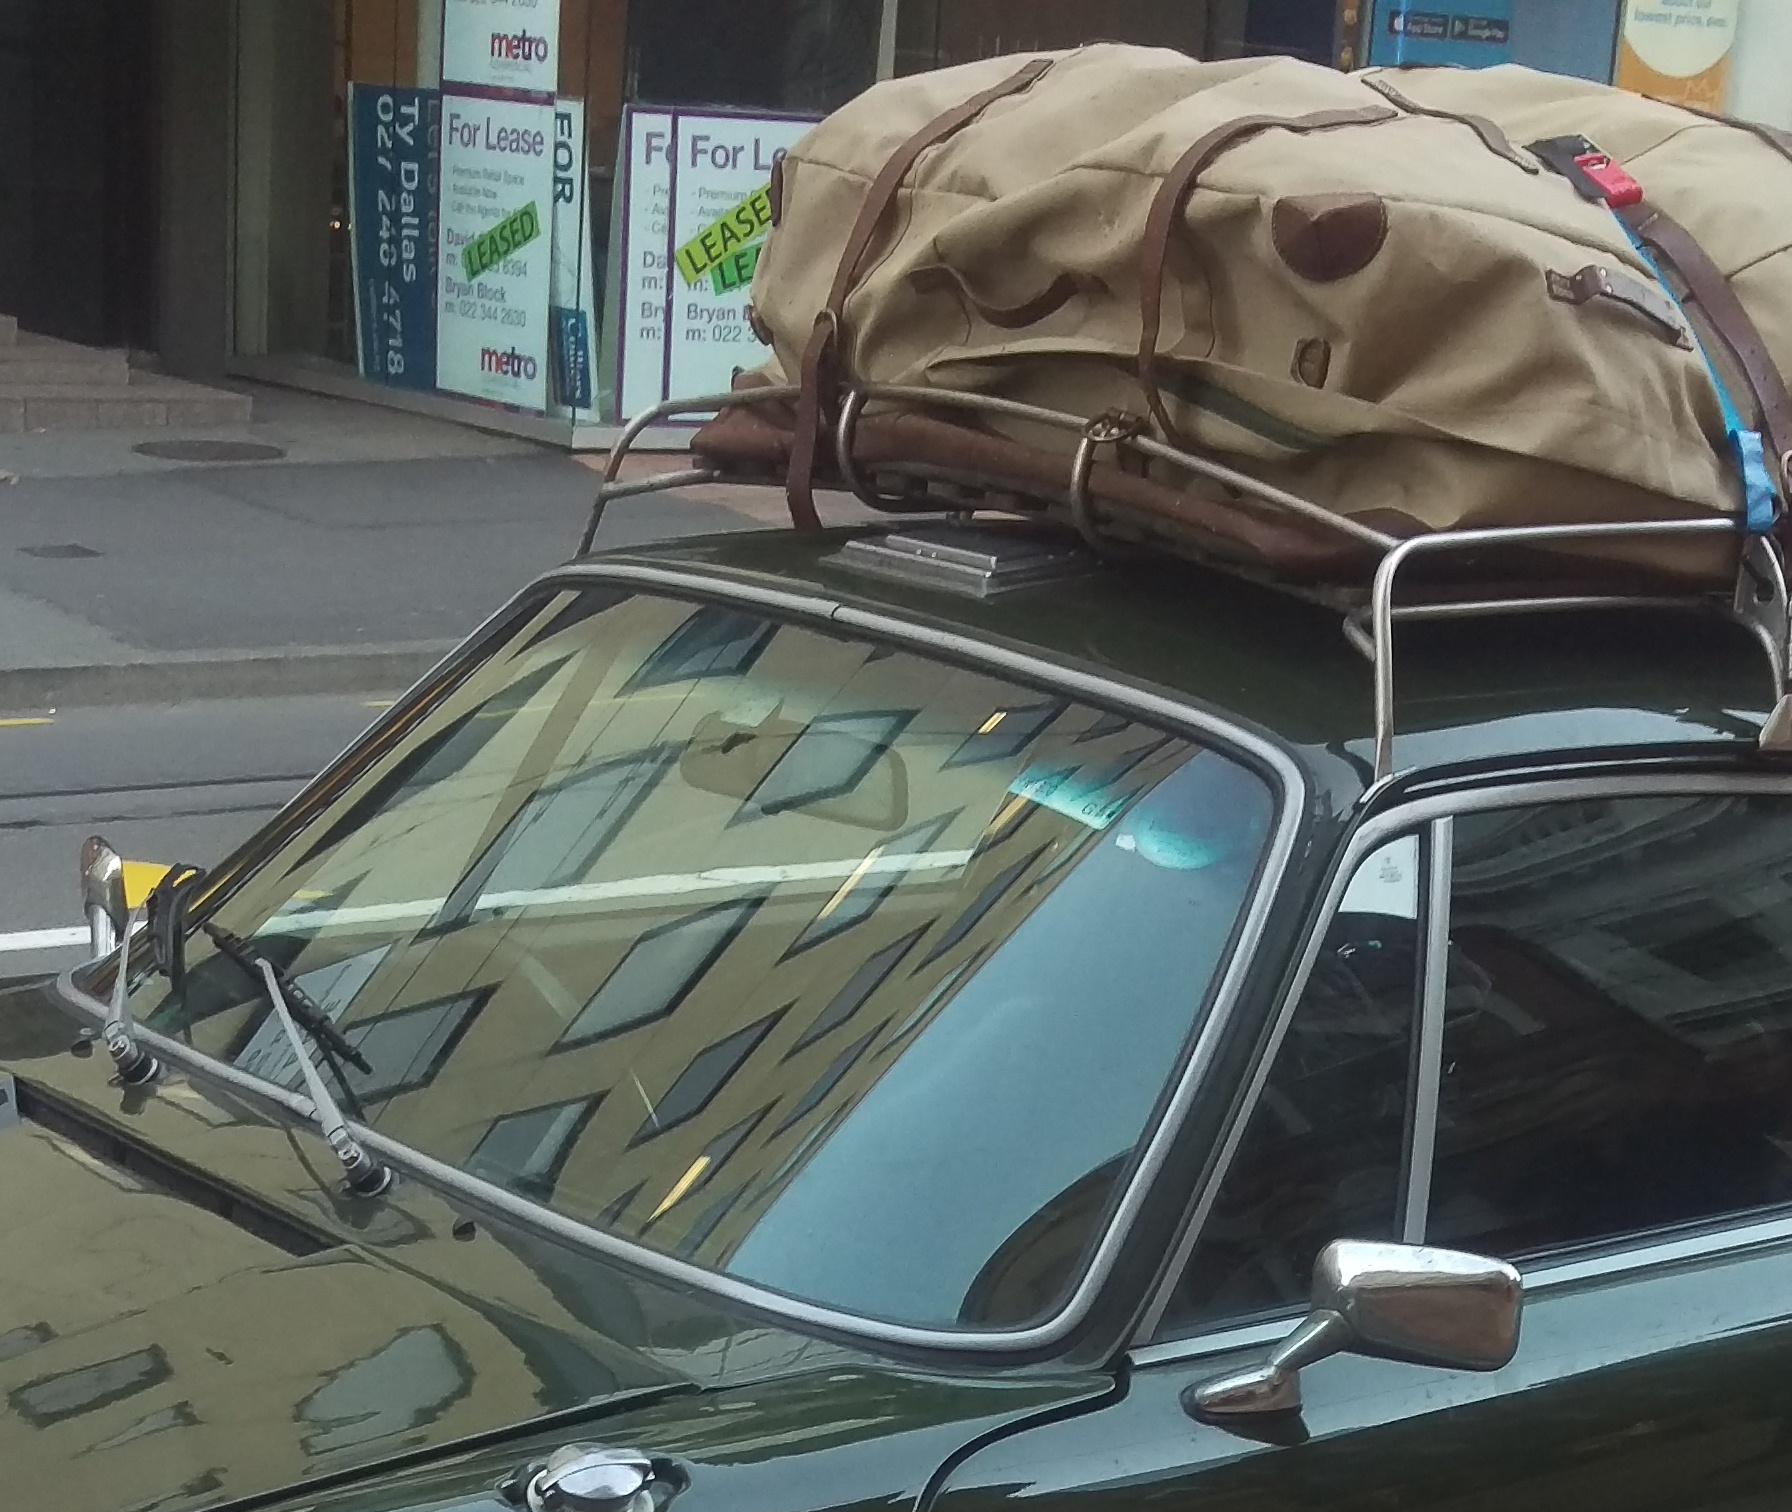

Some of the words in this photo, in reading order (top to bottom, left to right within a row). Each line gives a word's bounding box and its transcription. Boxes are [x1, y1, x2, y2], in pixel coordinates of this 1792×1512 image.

[490, 28, 549, 63] metro
[396, 97, 419, 146] Ty
[448, 112, 481, 148] For
[485, 116, 545, 157] Lease
[554, 111, 574, 205] FOR
[691, 134, 745, 170] For
[399, 161, 420, 282] Dallas
[465, 210, 535, 278] LEASED
[445, 276, 474, 298] Bryan
[687, 303, 737, 324] Bryan
[712, 325, 743, 342] 022
[480, 346, 537, 380] metro
